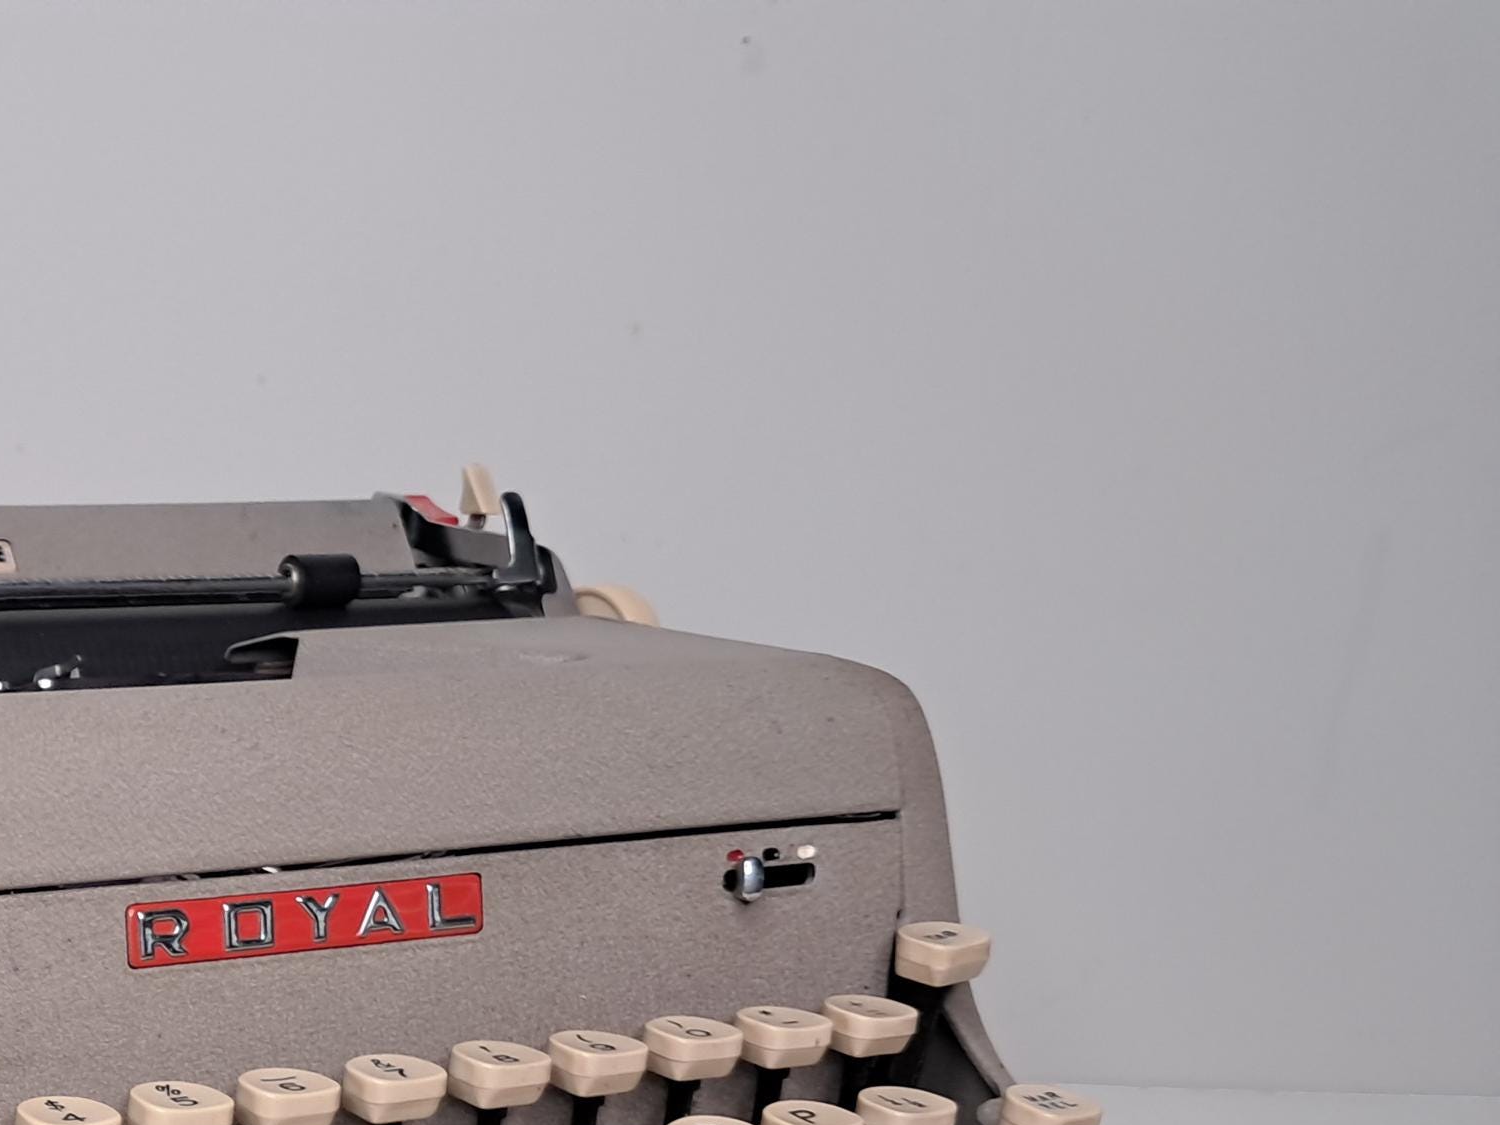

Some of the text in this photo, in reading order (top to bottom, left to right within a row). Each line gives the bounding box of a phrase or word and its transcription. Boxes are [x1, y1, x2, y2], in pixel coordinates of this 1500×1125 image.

[137, 882, 476, 960] ROYAL
[154, 1083, 182, 1097] %
[789, 1110, 816, 1124] P
